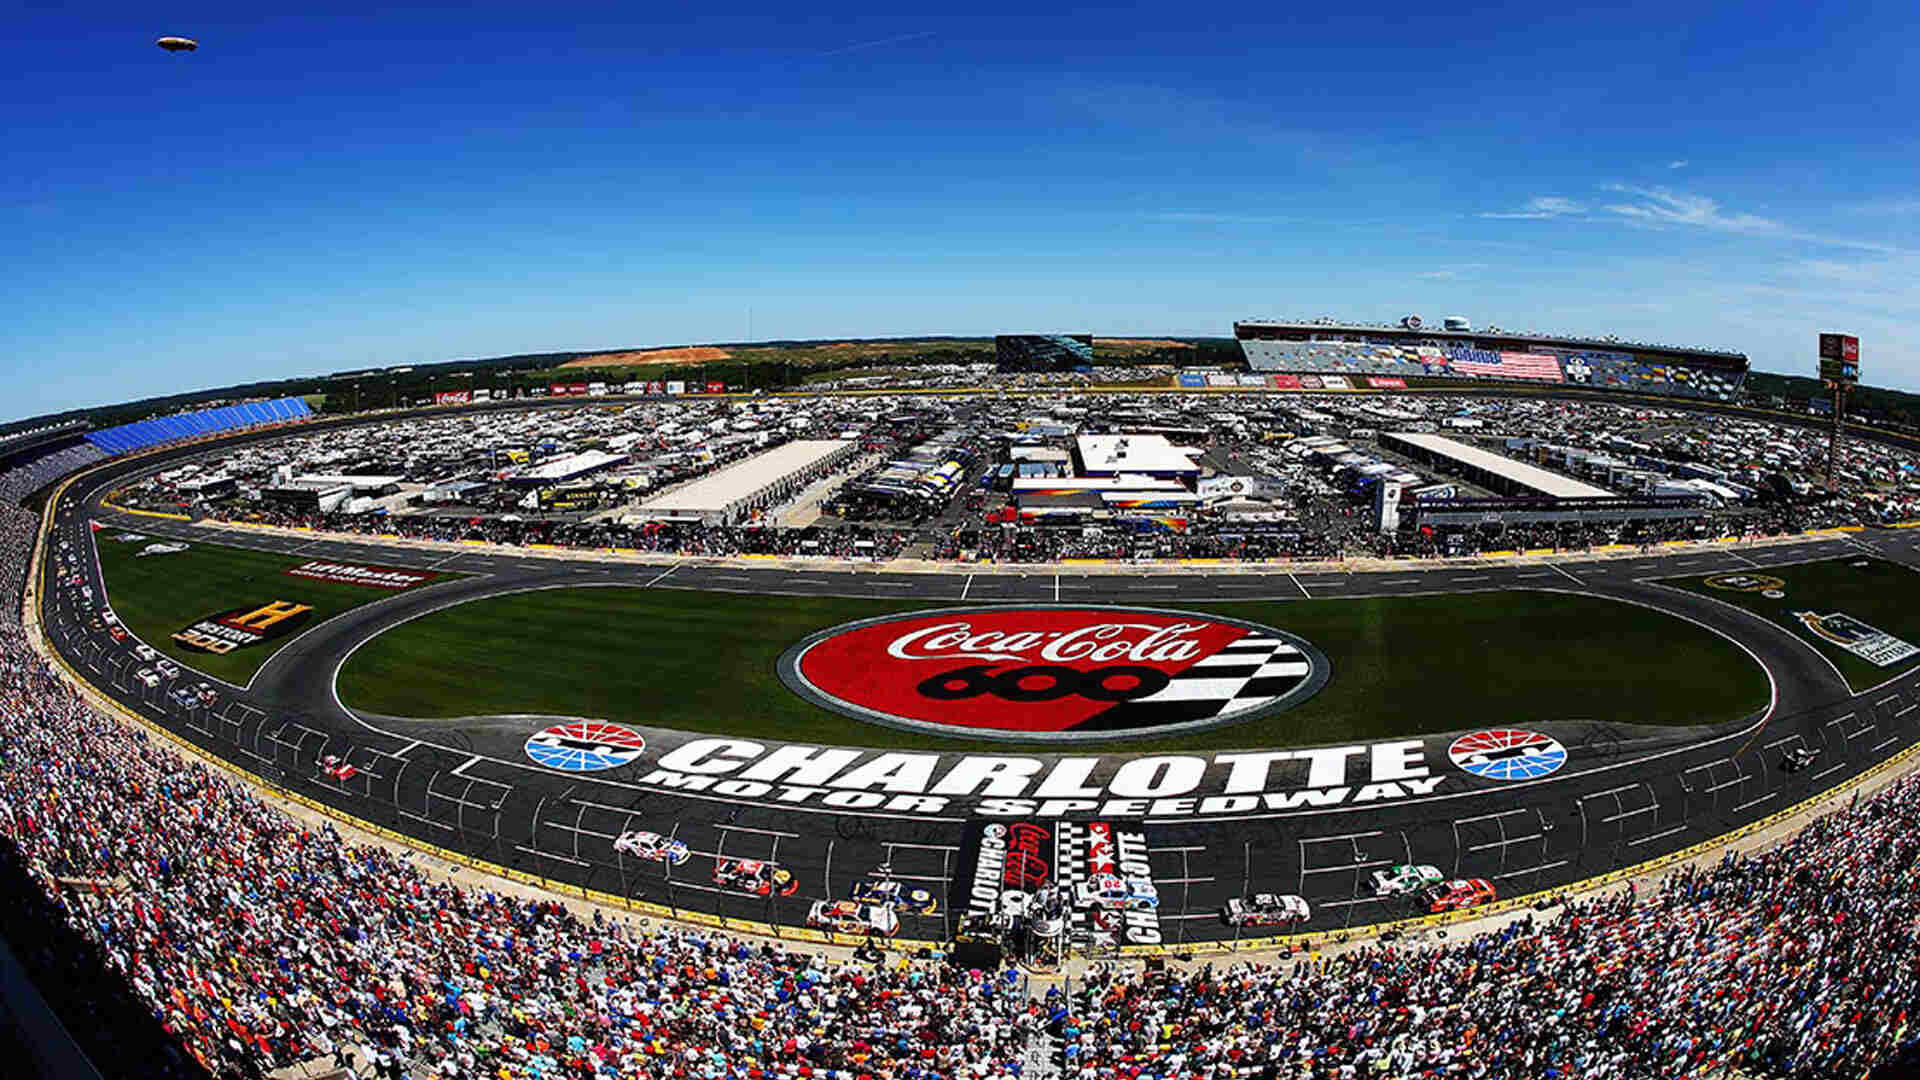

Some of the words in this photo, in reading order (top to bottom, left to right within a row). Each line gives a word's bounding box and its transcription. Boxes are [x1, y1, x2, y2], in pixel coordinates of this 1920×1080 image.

[228, 600, 316, 630] H
[168, 628, 240, 655] 300
[887, 622, 1213, 663] Coca-Cola
[916, 665, 1172, 702] 600
[657, 738, 1430, 799] CHARLOTTE
[638, 770, 951, 814] MOTOR
[973, 776, 1446, 817] SPEEDWAY
